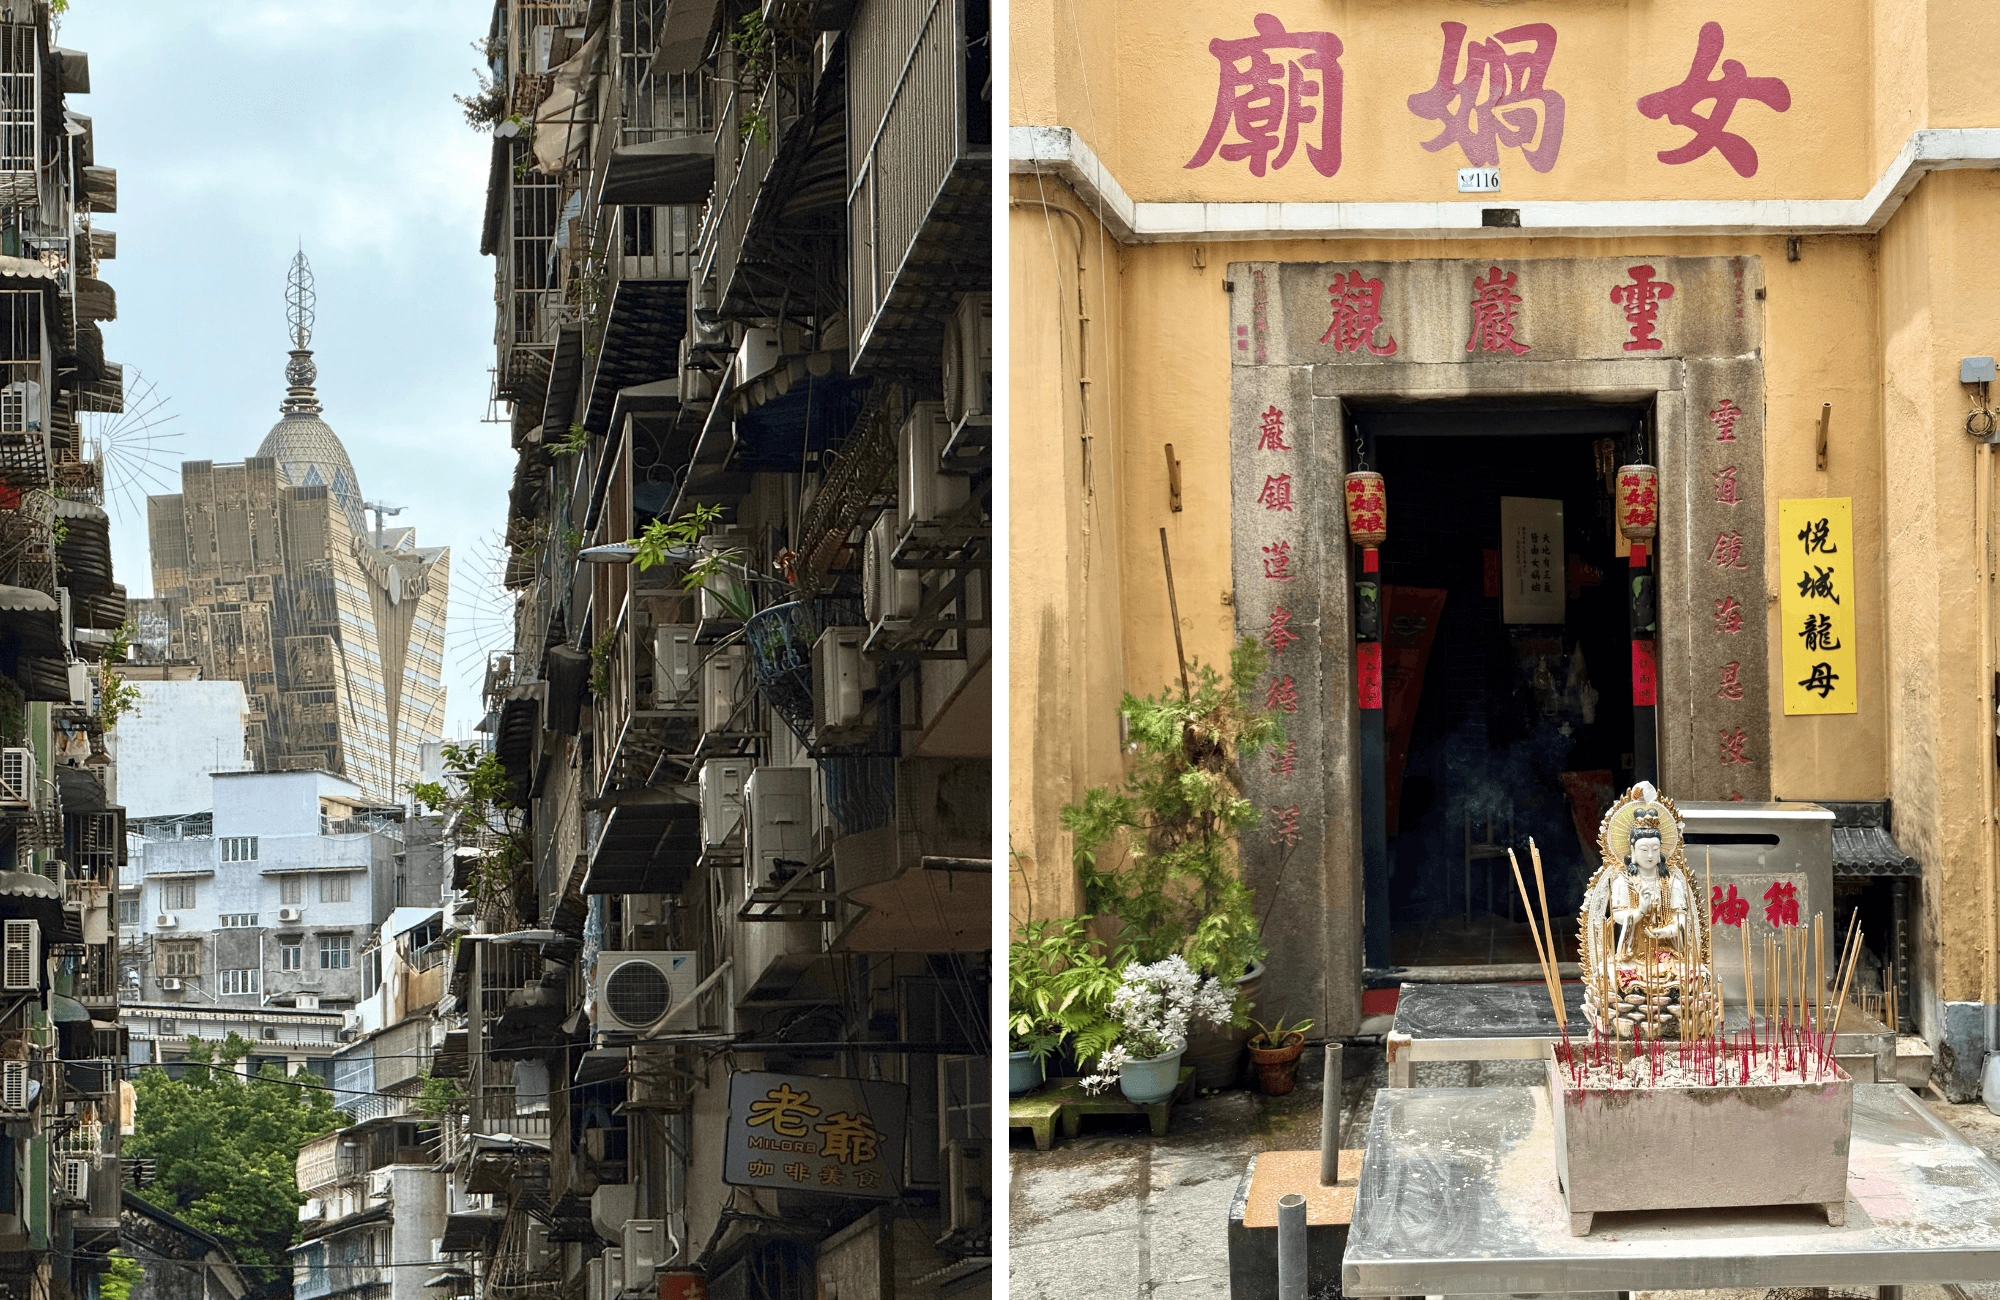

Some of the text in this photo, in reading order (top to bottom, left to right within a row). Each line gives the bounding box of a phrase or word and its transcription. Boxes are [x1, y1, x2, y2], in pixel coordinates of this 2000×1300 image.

[1183, 13, 1791, 178] 女媧廟
[1476, 171, 1499, 188] 116
[1707, 399, 1753, 801] 靈通鏡海恩波
[746, 1083, 887, 1165] 老爺
[748, 1159, 883, 1189] 咖啡美食
